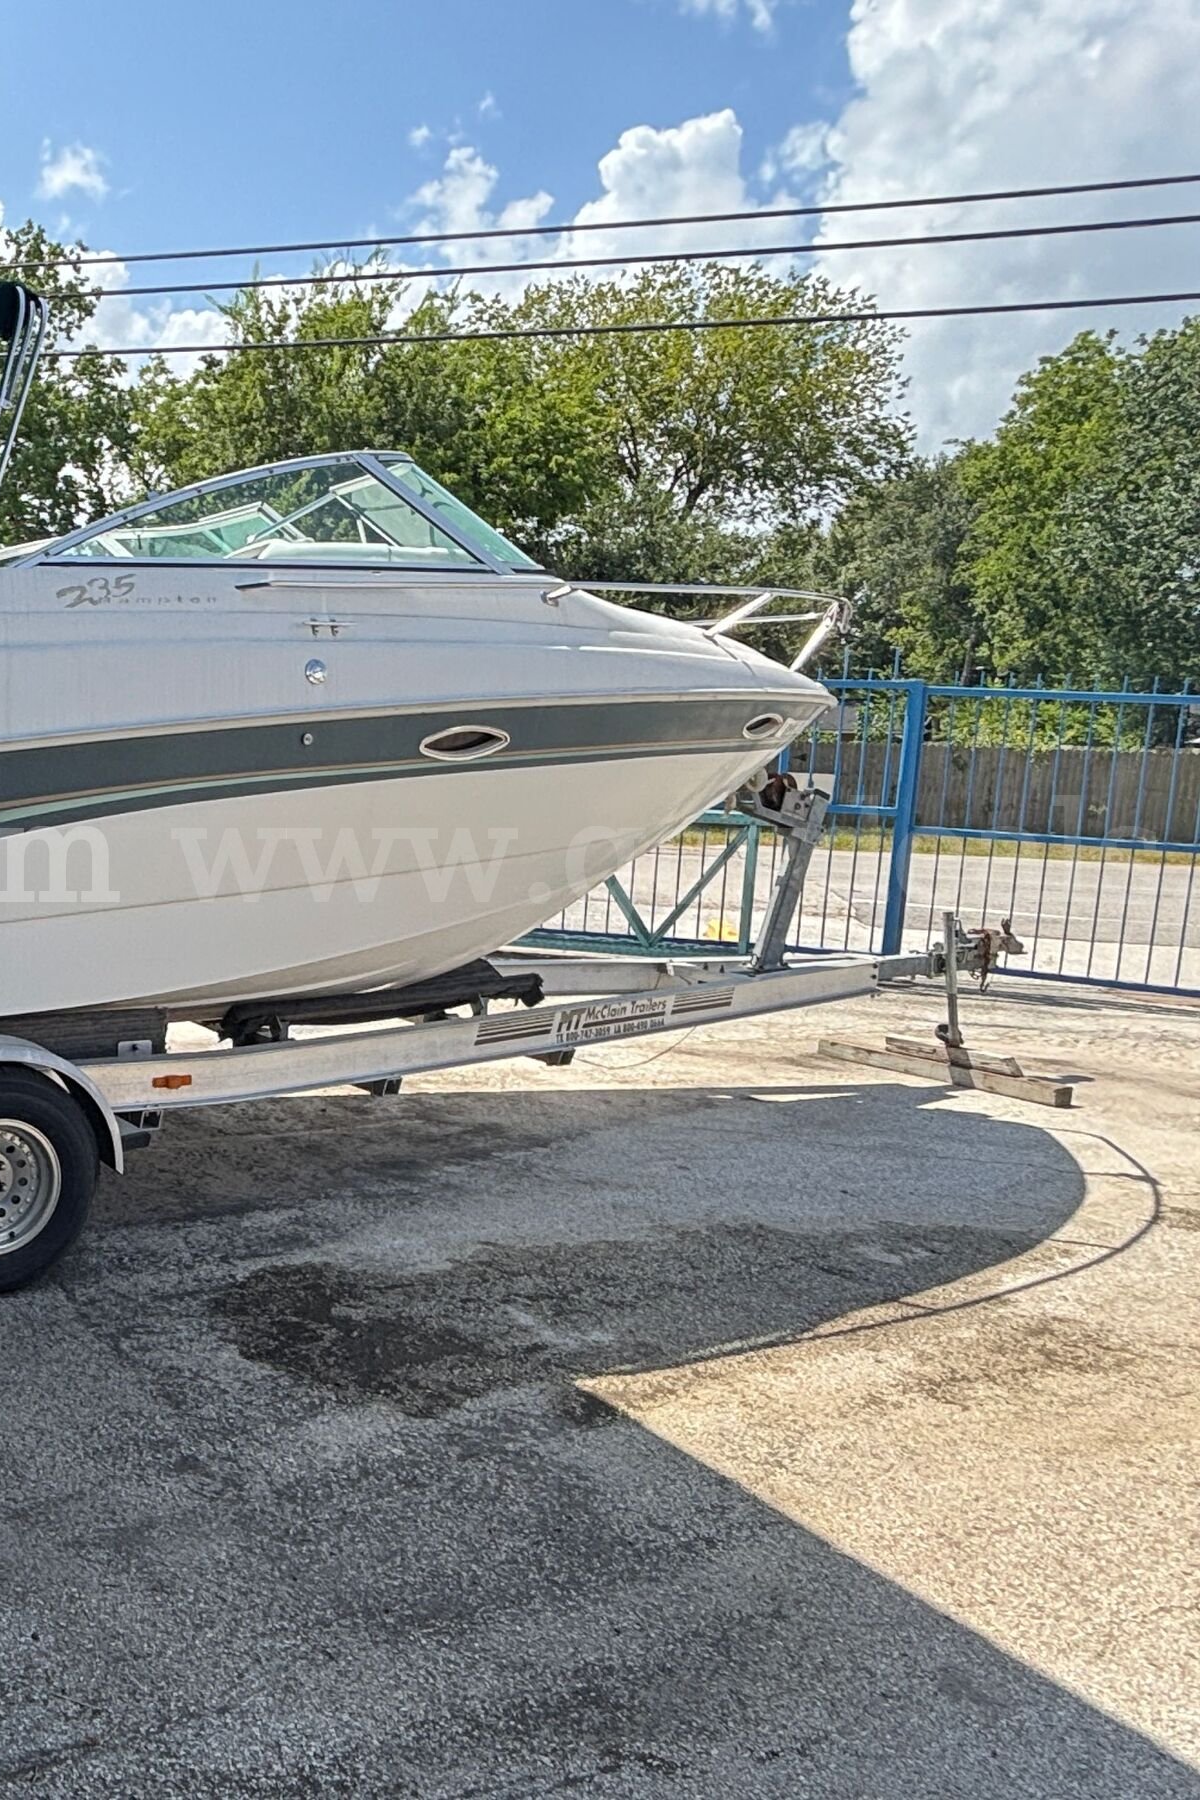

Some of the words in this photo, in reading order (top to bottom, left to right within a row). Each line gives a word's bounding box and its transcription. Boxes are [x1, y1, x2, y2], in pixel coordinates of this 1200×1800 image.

[56, 574, 137, 608] 235
[585, 1003, 627, 1021] McClain
[630, 998, 667, 1014] Trailers
